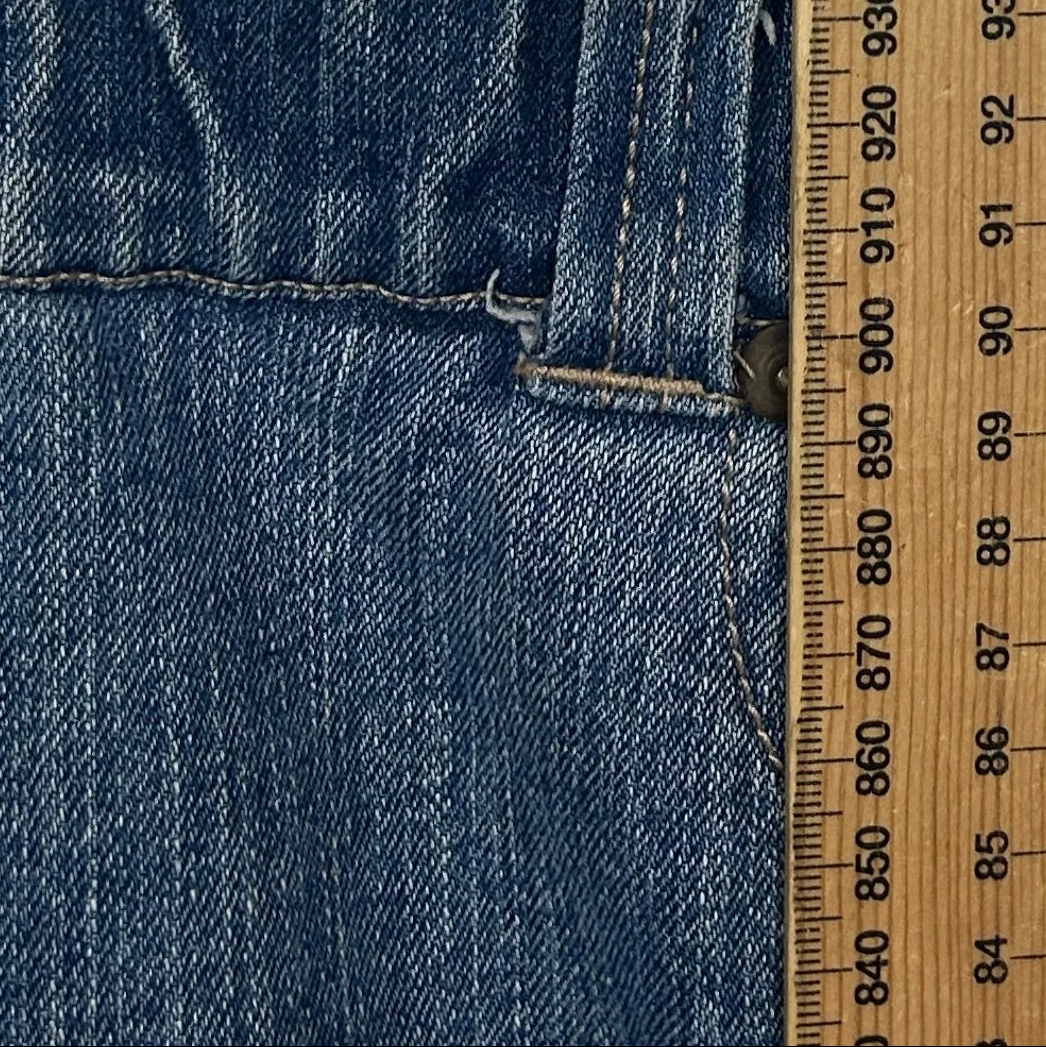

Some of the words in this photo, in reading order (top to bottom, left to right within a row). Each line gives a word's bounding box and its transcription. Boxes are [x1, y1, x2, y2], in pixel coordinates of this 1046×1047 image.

[861, 85, 897, 164] 920
[980, 94, 1015, 146] 92
[859, 187, 895, 266] 910
[979, 204, 1014, 248] 91
[858, 297, 894, 375] 900
[978, 305, 1013, 356] 90
[857, 403, 893, 481] 890
[977, 411, 1012, 461] 89
[857, 509, 892, 588] 880
[976, 513, 1011, 567] 88
[856, 615, 891, 691] 870
[975, 622, 1010, 672] 87
[855, 720, 890, 797] 860
[975, 726, 1010, 778] 86
[854, 825, 890, 903] 850
[974, 831, 1009, 883] 85
[854, 930, 889, 1005] 840
[974, 934, 1008, 984] 84
